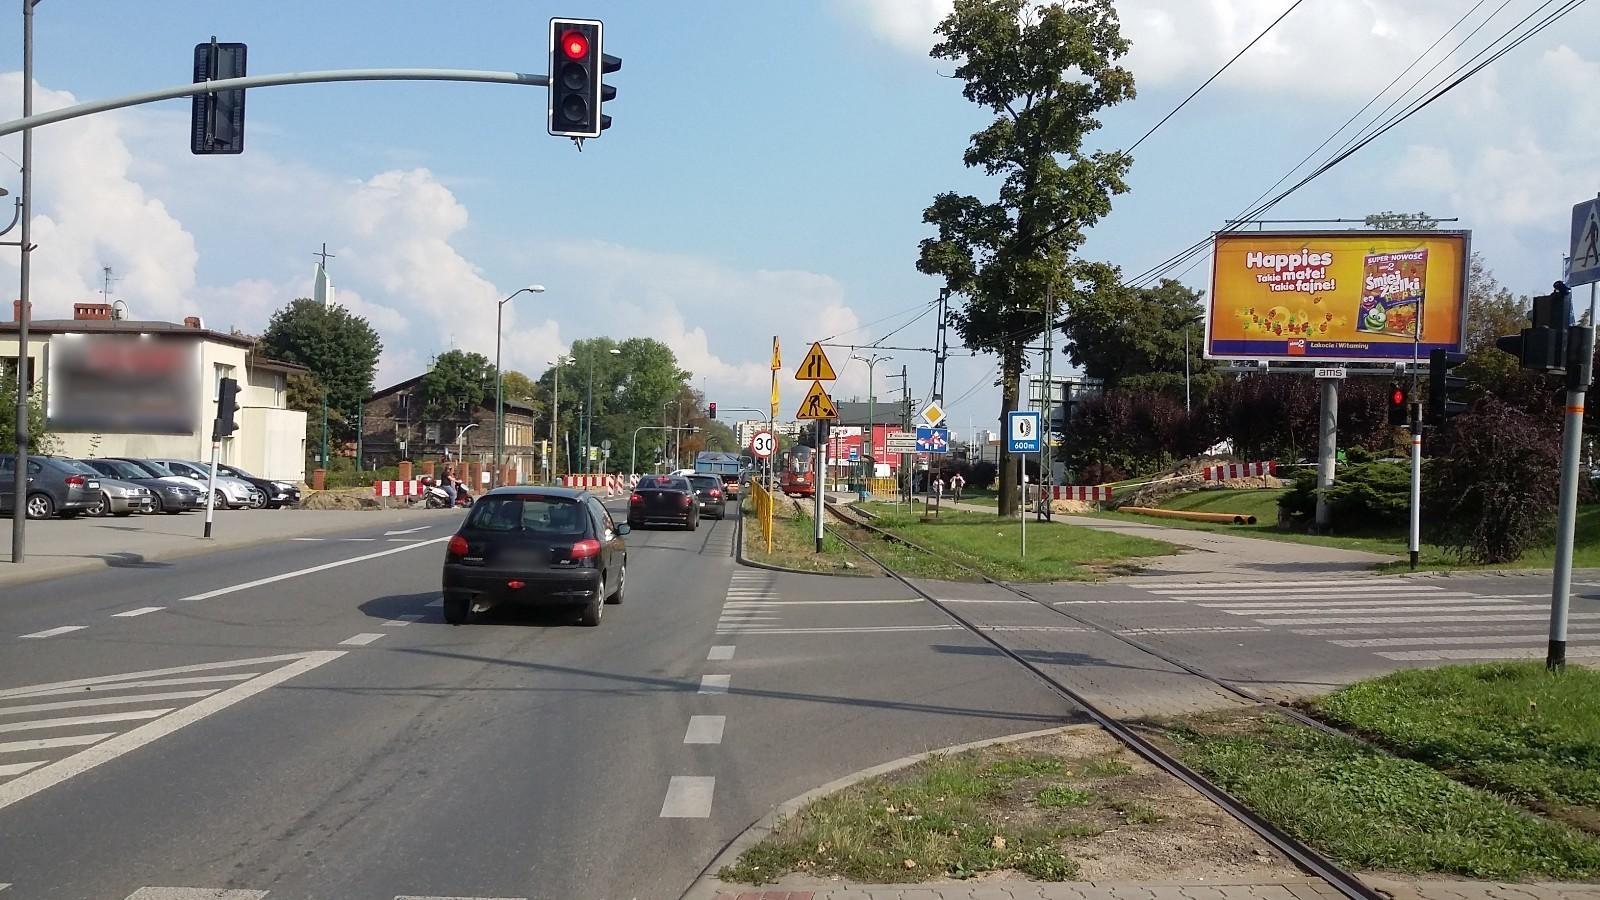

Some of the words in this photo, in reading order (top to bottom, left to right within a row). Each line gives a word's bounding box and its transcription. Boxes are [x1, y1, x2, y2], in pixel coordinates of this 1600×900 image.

[1246, 248, 1333, 273] Happies
[1368, 255, 1389, 263] SUPER
[1391, 252, 1423, 261] NOWOŚĆ
[1256, 274, 1281, 283] Takie
[1282, 267, 1326, 281] małe!
[1366, 270, 1401, 291] Śmiej
[1270, 282, 1295, 292] Takie
[1296, 279, 1336, 294] fajne!
[1319, 369, 1343, 377] ams
[755, 437, 774, 451] 30
